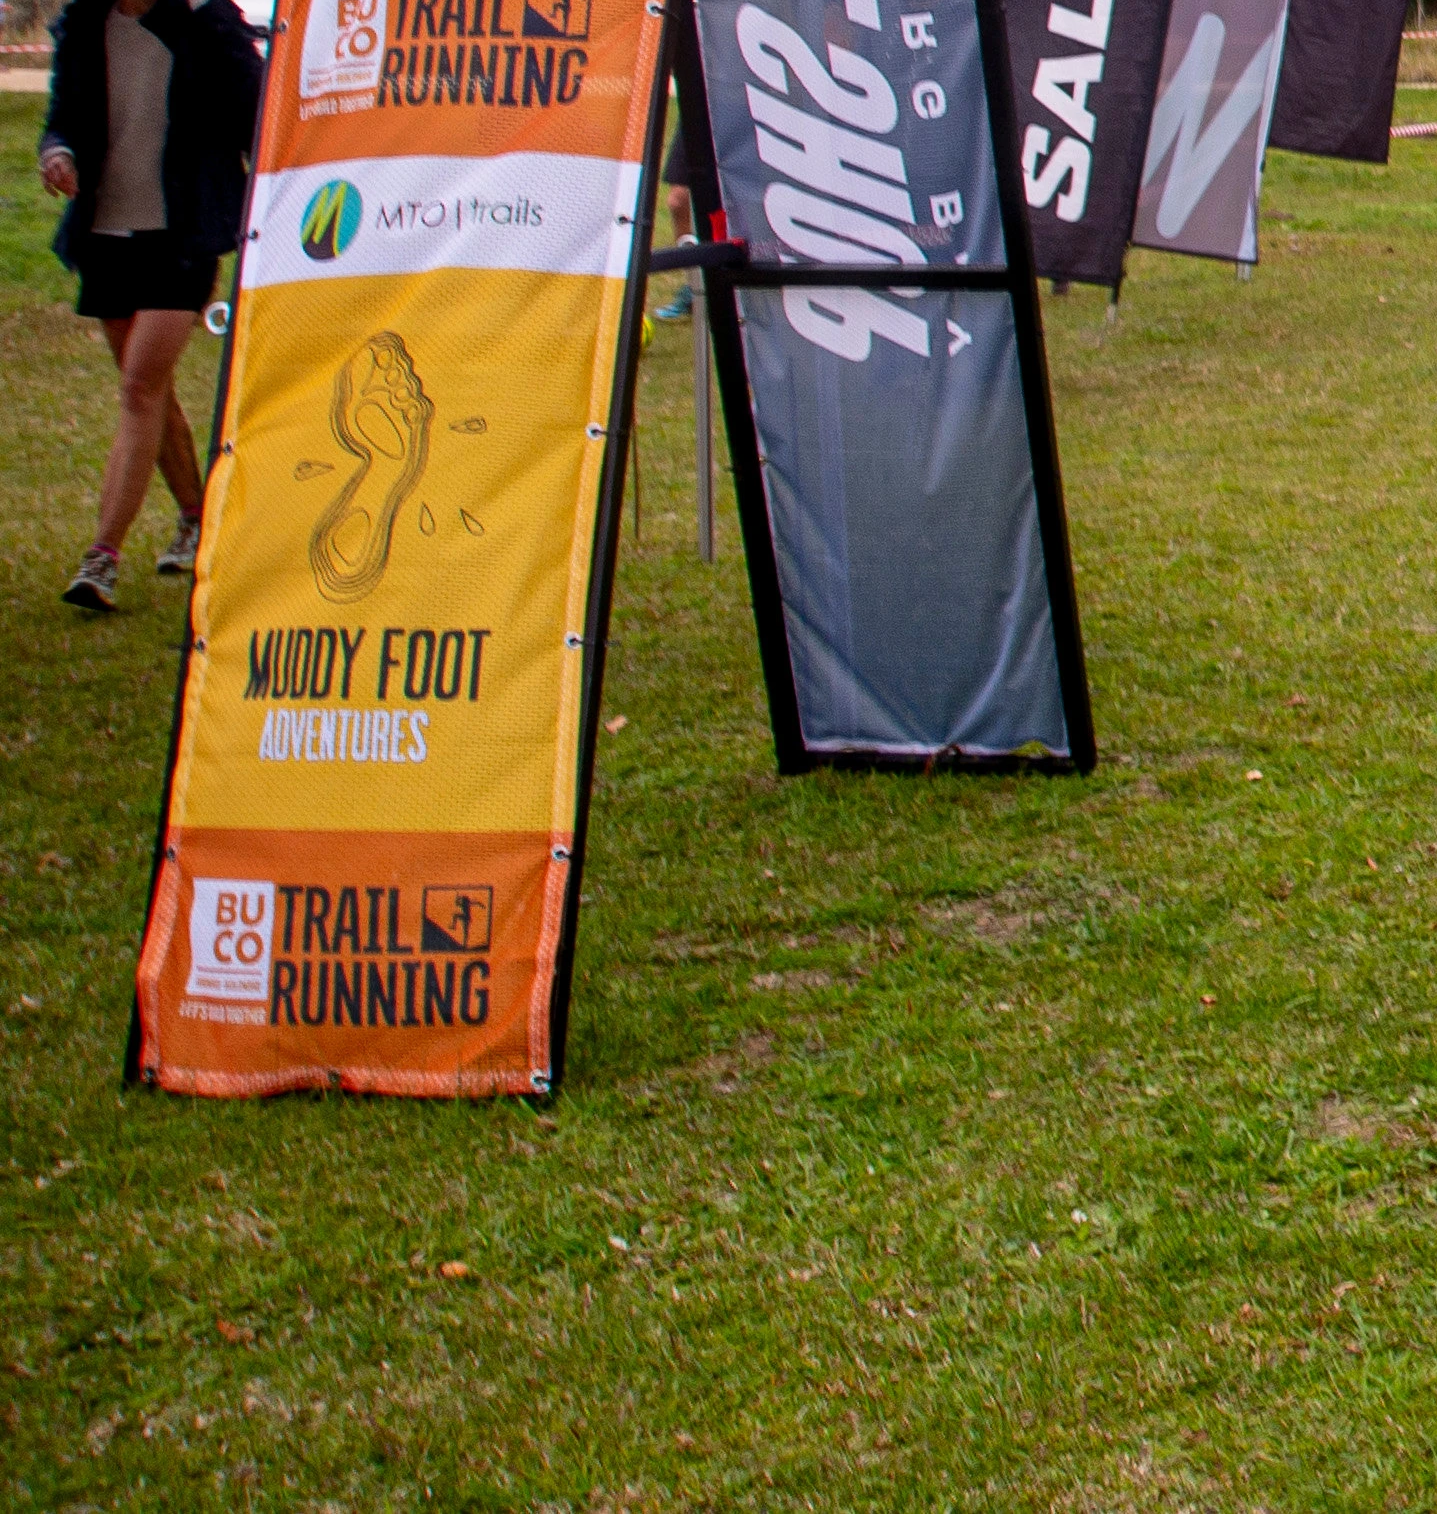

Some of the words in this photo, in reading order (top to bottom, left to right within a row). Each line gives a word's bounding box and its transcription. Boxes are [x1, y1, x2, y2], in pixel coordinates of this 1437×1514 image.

[377, 44, 588, 109] RUNNING
[375, 198, 446, 228] MTO
[467, 195, 546, 228] trails
[243, 627, 366, 702] MUDDY
[377, 627, 492, 702] FOOT
[258, 707, 430, 763] ADVENTURES
[216, 891, 265, 927] BU
[278, 885, 414, 954] TRAIL
[213, 930, 264, 965] CO
[269, 959, 491, 1028] RUNNING
